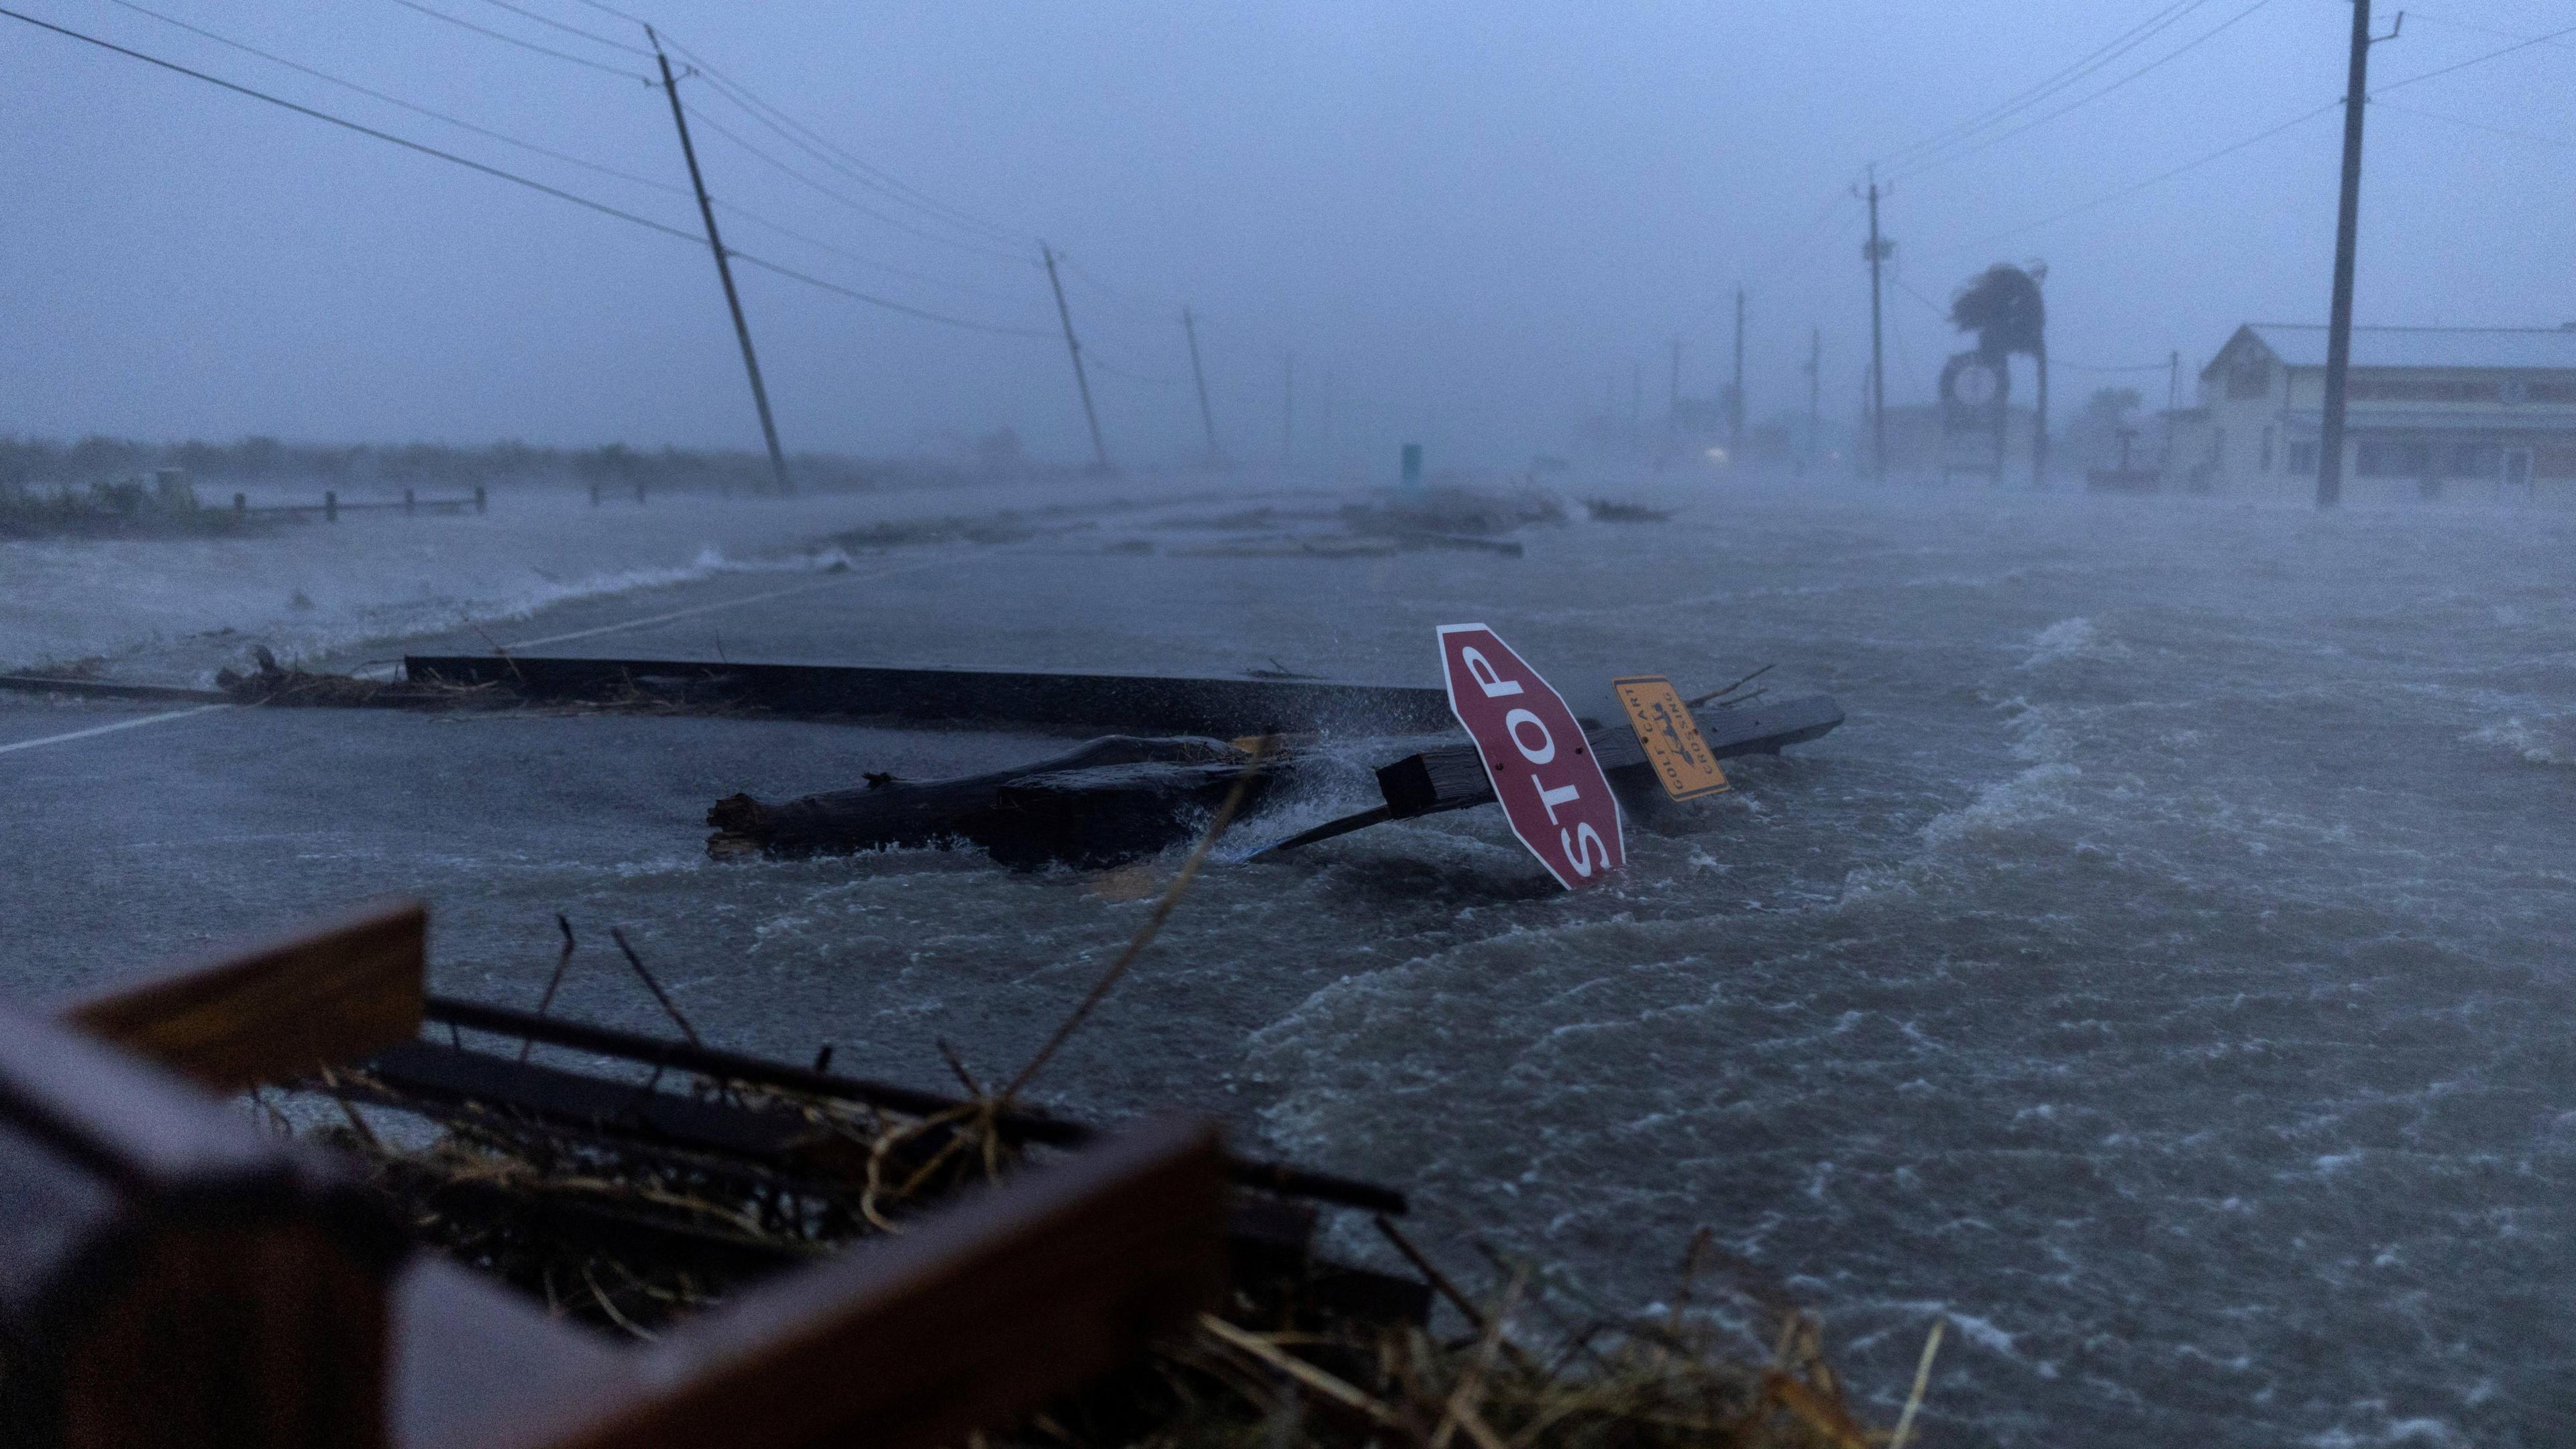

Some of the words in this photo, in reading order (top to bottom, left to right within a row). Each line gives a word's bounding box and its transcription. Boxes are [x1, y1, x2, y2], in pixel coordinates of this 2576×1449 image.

[1625, 688, 1653, 732] CART
[1664, 692, 1713, 775] CROSSING
[1462, 646, 1609, 877] STOP
[1653, 746, 1684, 790] GOLF
